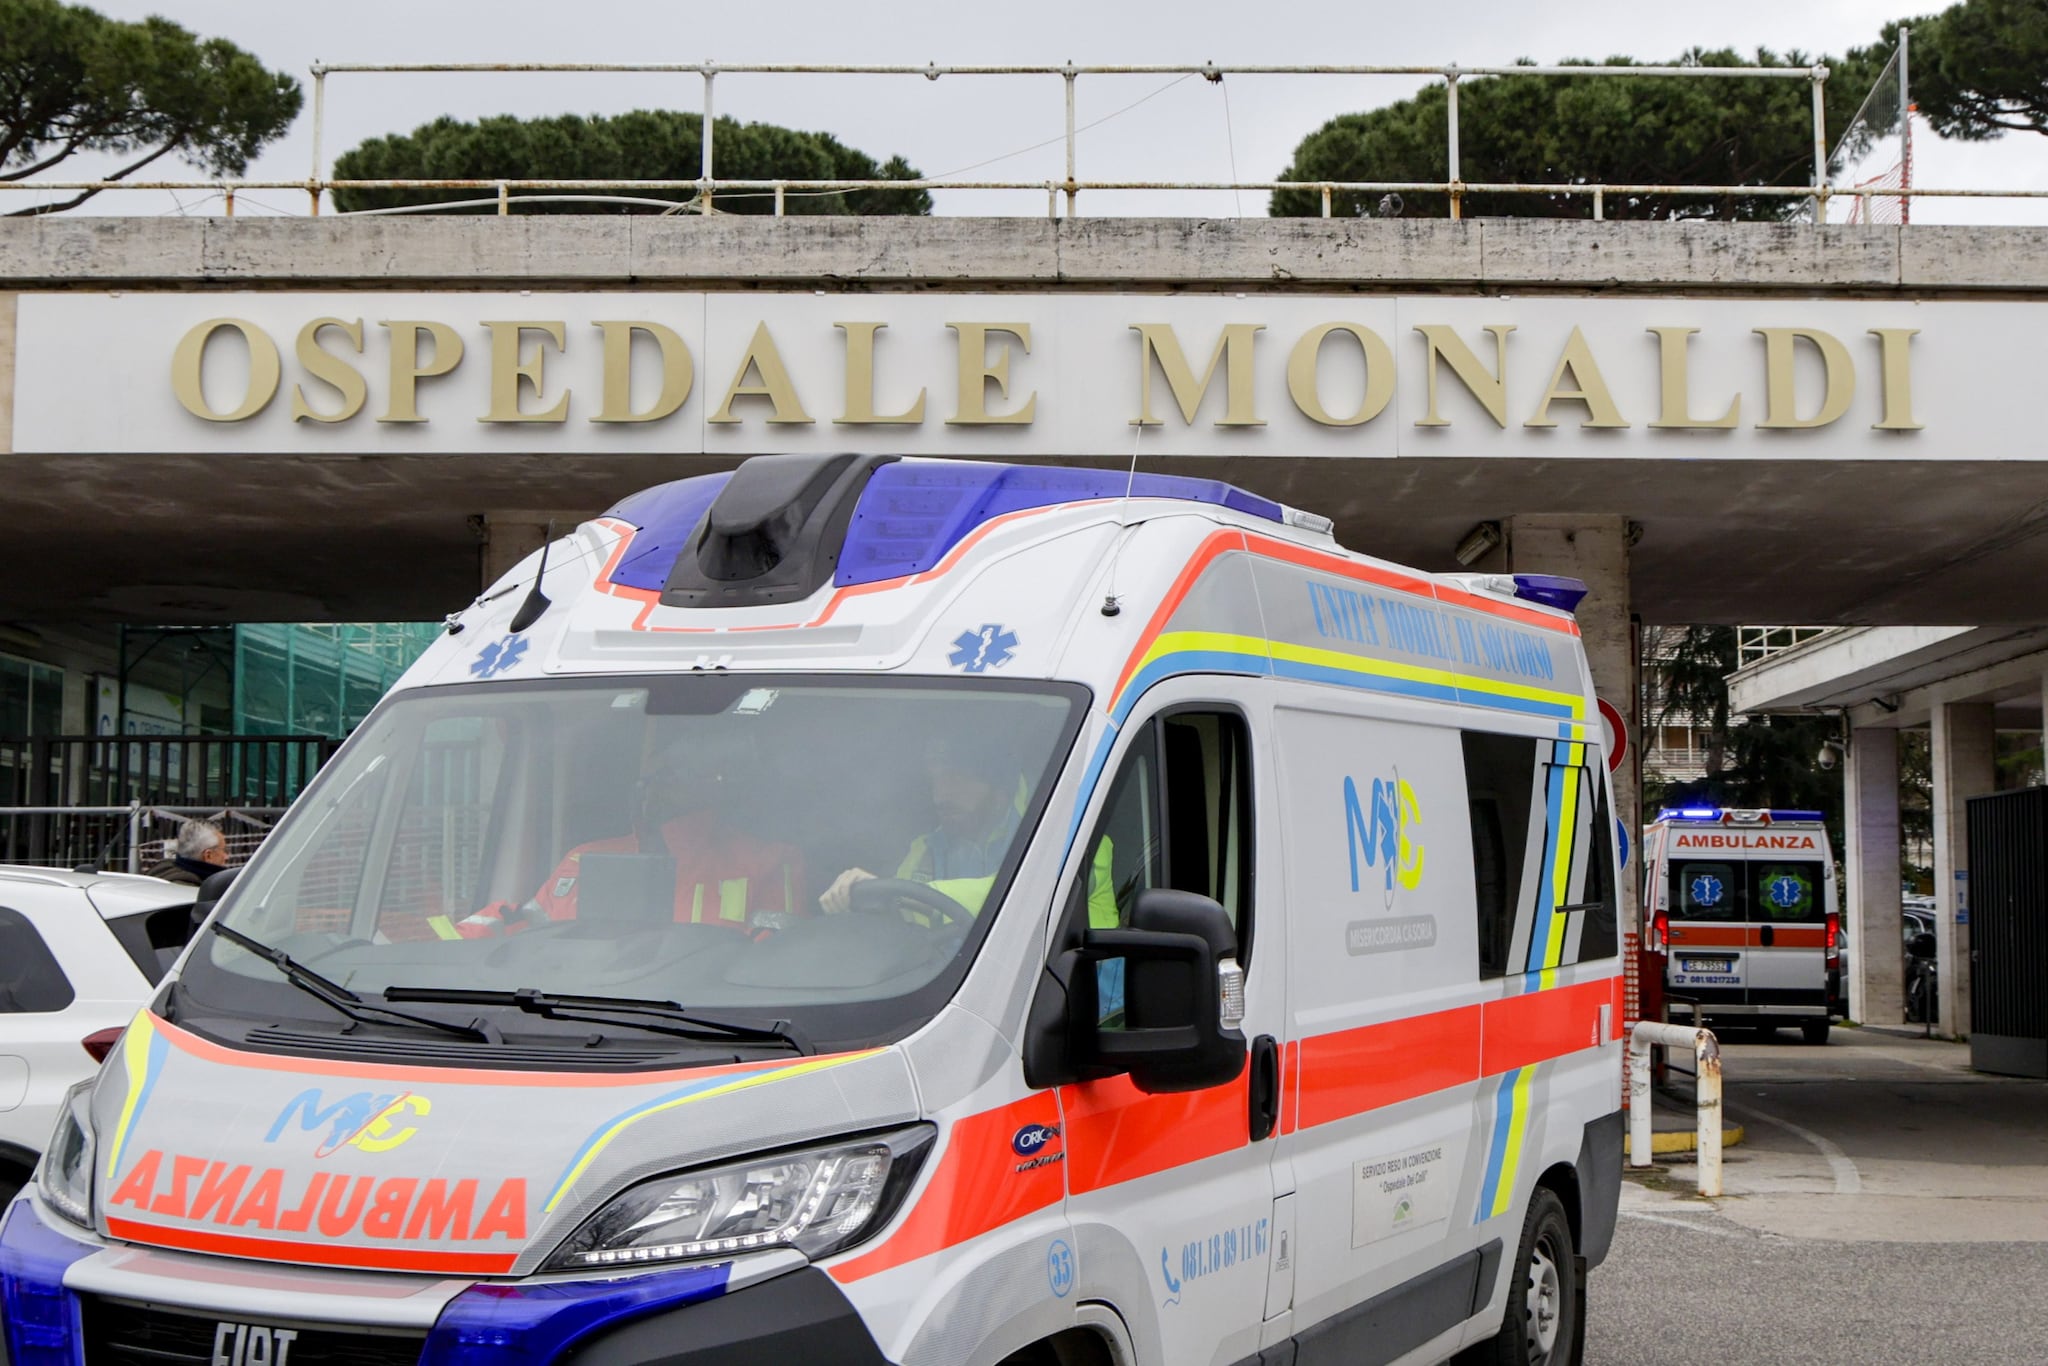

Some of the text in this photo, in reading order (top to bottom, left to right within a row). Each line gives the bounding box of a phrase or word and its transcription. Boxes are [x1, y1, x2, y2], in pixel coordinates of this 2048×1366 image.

[171, 317, 1925, 432] OSPEDALE MONALDI
[1454, 616, 1480, 665] DI
[1477, 622, 1554, 681] SOCCORSO
[1676, 834, 1815, 849] AMBULANZA
[1362, 1148, 1441, 1179] SERVIZIO RESO IN CONVENZIONE
[1223, 1228, 1237, 1268] 89
[1240, 1223, 1252, 1261] 11
[1255, 1217, 1268, 1257] 67
[211, 1322, 299, 1366] FIAT
